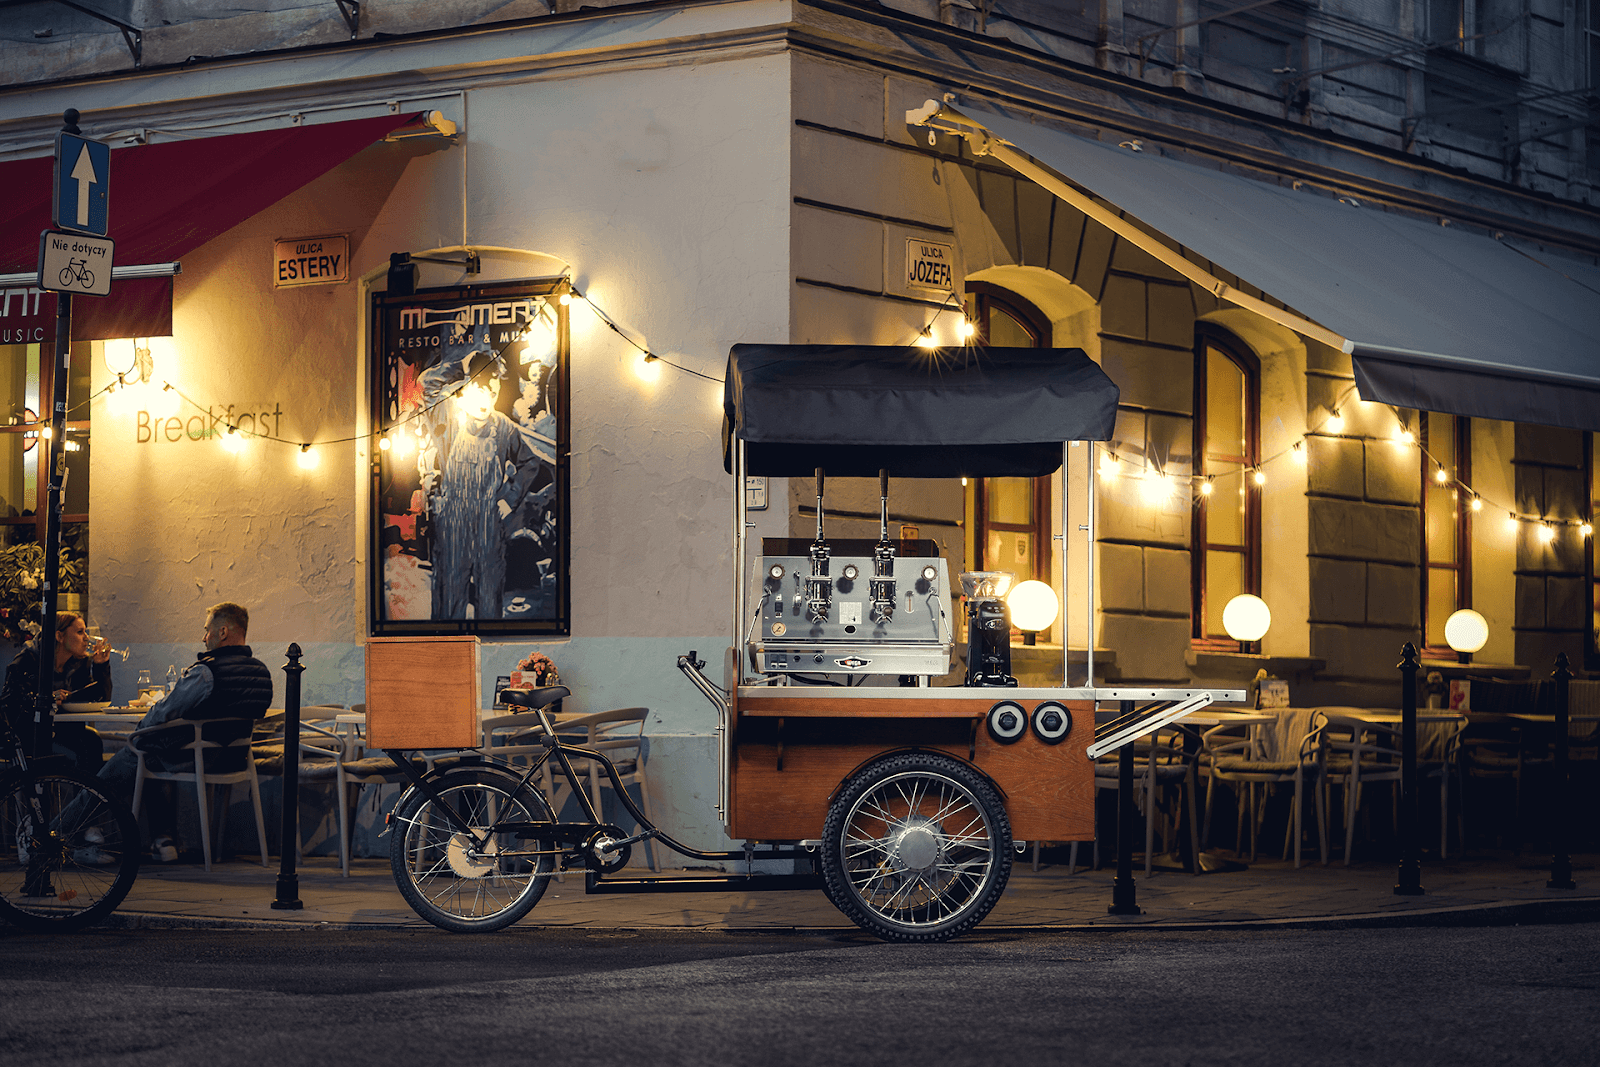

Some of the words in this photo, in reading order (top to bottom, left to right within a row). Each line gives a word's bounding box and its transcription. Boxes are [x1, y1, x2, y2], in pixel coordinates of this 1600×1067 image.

[52, 238, 68, 251] Nie
[71, 241, 107, 258] dotyczy
[296, 243, 323, 255] ULICA
[920, 245, 944, 259] ULICA
[279, 254, 341, 281] ESTERY
[909, 257, 952, 287] JÓZEFA
[3, 327, 44, 343] USIC
[399, 335, 440, 349] RESTO
[449, 334, 474, 345] BAR
[483, 333, 491, 344] &
[137, 402, 283, 443] Breakfast
